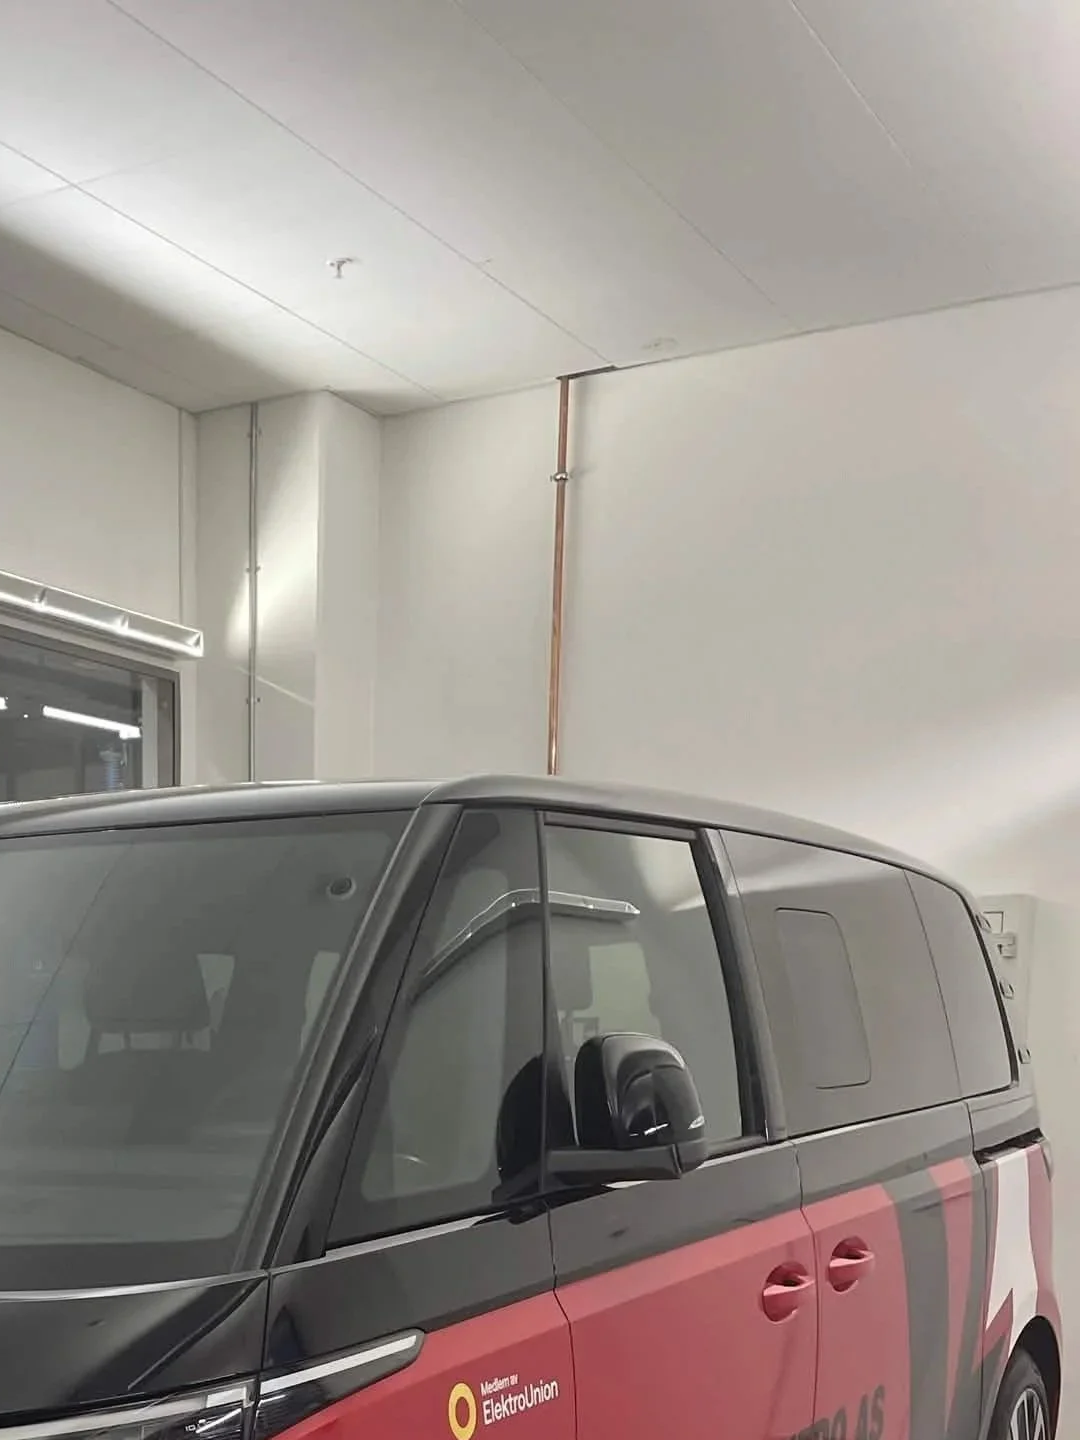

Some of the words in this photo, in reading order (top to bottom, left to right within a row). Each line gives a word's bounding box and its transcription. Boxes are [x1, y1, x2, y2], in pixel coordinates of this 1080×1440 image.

[480, 1377, 510, 1396] Medlem
[510, 1374, 519, 1386] av
[482, 1379, 559, 1425] ElektroUnion
